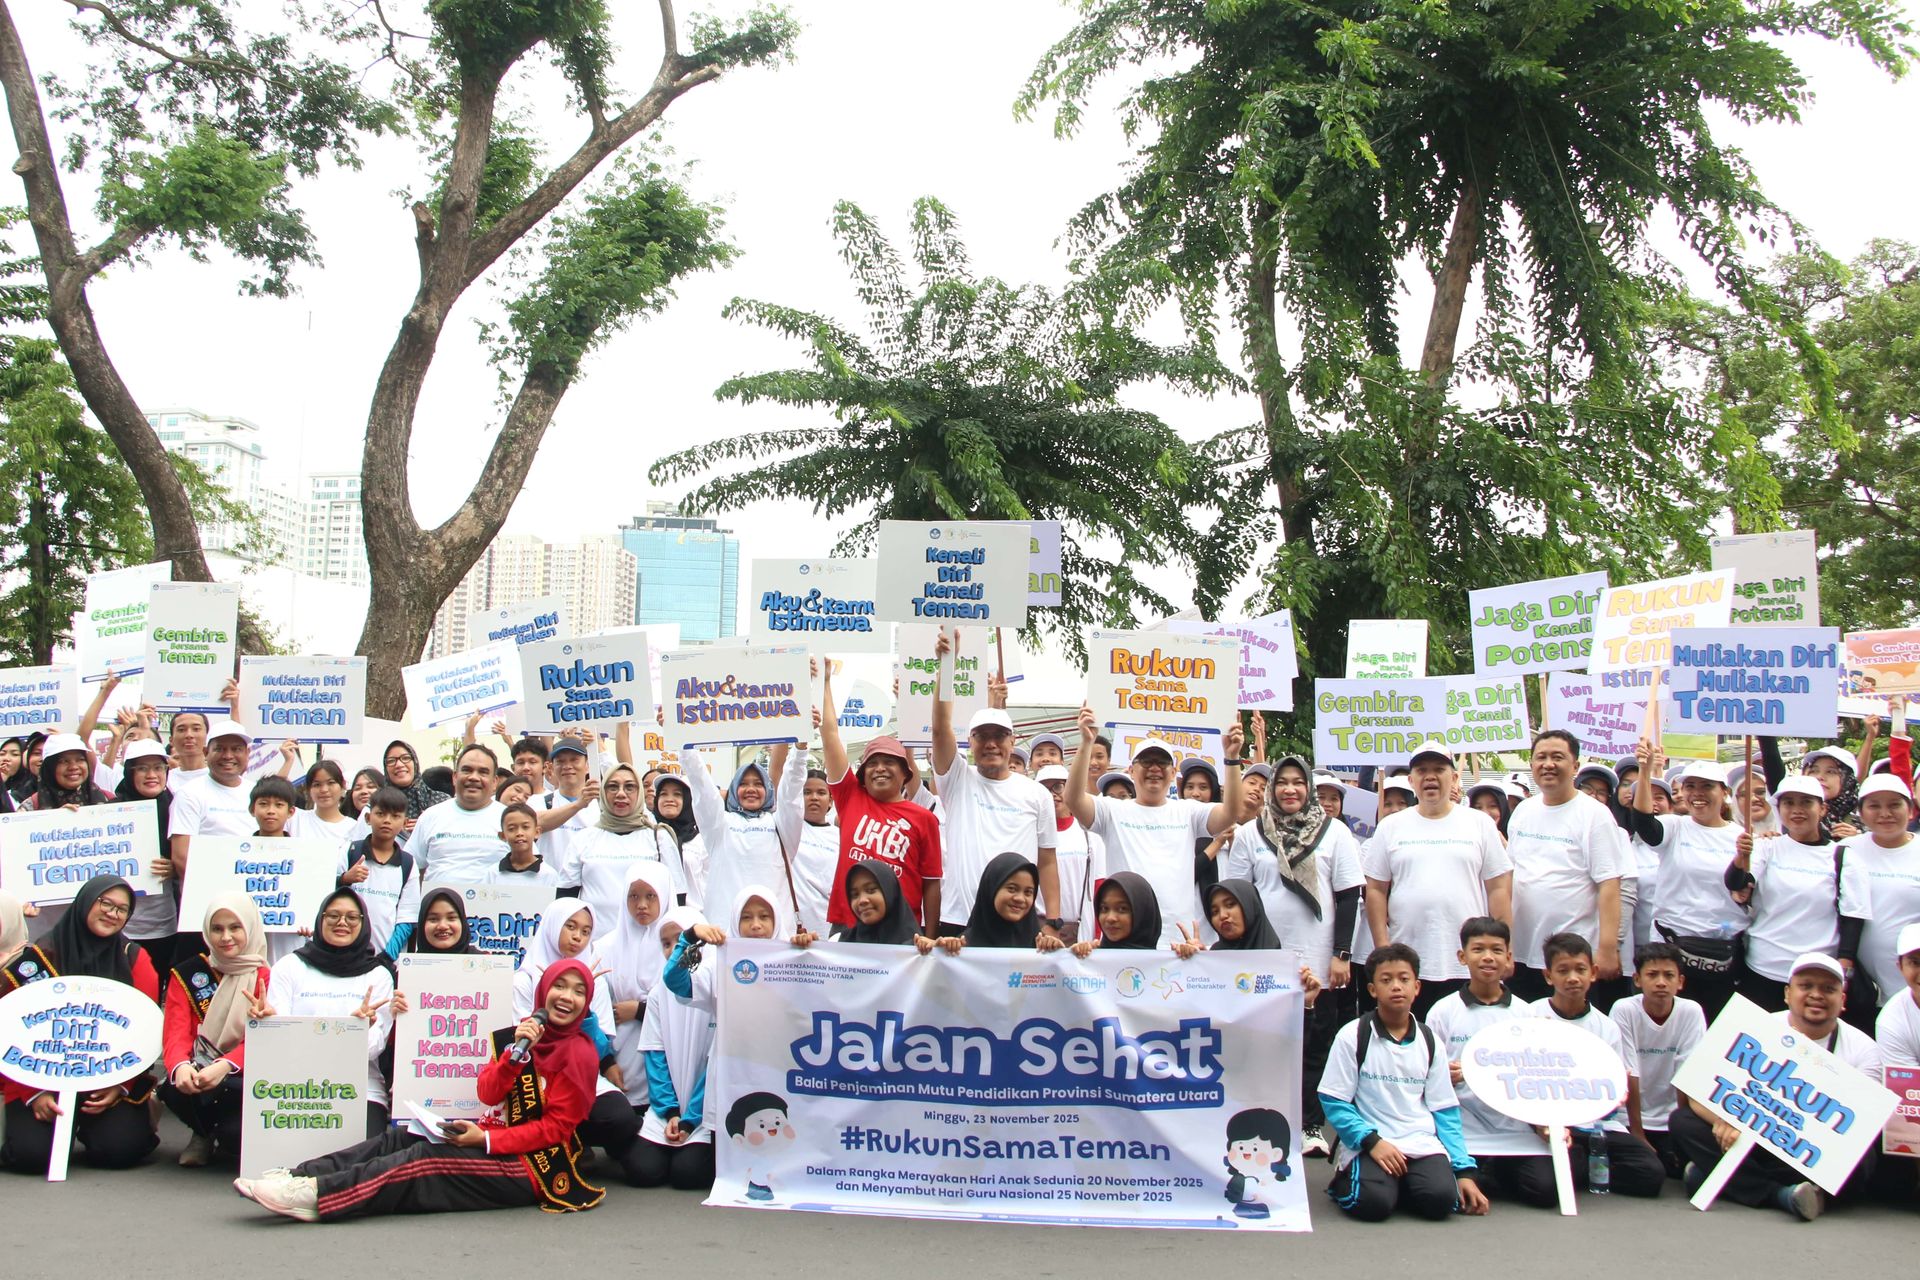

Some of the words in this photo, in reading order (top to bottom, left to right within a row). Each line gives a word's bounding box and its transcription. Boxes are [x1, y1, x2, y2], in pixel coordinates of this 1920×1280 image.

[926, 547, 985, 565] Kenali
[938, 565, 972, 582] Diri
[924, 582, 984, 600] Kenali
[1607, 577, 1725, 618] RUKUN
[1734, 582, 1769, 600] aga
[1772, 576, 1806, 593] Diri
[91, 602, 149, 622] Gembir
[760, 591, 801, 611] Aku
[912, 597, 990, 619] Teman
[1475, 601, 1544, 631] Jaga
[1549, 587, 1604, 618] Dir
[488, 623, 534, 641] Muliakan
[534, 611, 559, 629] Diri
[768, 611, 872, 632] Istimewa
[1534, 617, 1592, 639] Kenali
[1629, 611, 1697, 635] Sama
[153, 627, 228, 643] Gembira
[515, 627, 557, 645] liakan
[158, 650, 217, 664] Teman
[170, 642, 209, 651] Bersama
[1486, 637, 1593, 666] Potens
[1603, 634, 1671, 664] Tem
[1673, 643, 1784, 668] Muliakan
[1791, 642, 1836, 668] Diri
[1872, 642, 1920, 654] Gembira
[1110, 648, 1215, 679] Rukun
[1352, 652, 1388, 665] Jaga
[1393, 651, 1416, 663] Diri
[1854, 655, 1900, 665] bersama
[262, 674, 320, 686] Muliakan
[323, 675, 346, 686] Diri
[425, 661, 478, 683] Muliakan
[480, 656, 501, 671] Diri
[539, 659, 634, 690] Rukun
[39, 680, 61, 691] Diri
[434, 670, 501, 695] Muliakan
[676, 676, 721, 698] Aku
[1135, 677, 1188, 692] Sama
[1696, 669, 1809, 694] Muliakan
[0, 694, 57, 709] uliakan
[268, 689, 342, 703] Muliakan
[428, 679, 509, 712] Teman
[565, 686, 612, 703] Sama
[1115, 688, 1208, 714] Teman
[1318, 690, 1424, 713] Gembira
[1475, 682, 1524, 706] Diri
[258, 704, 346, 725] Teman
[547, 699, 633, 724] Teman
[676, 699, 801, 725] Istimewa
[1463, 706, 1512, 722] Kenali
[1673, 690, 1784, 724] Teman
[1350, 714, 1414, 726] Bersama
[1599, 716, 1636, 733] Jalan
[1446, 719, 1524, 744] otensi
[30, 826, 103, 844] Muliakan
[107, 820, 134, 837] Diri
[40, 839, 132, 862] Muliakan
[28, 857, 139, 886] Teman
[235, 859, 294, 875] Kenali
[246, 876, 279, 892] Diri
[498, 912, 542, 937] Diri
[478, 937, 520, 950] Kenali
[785, 963, 827, 971] PENJAMINAN
[848, 967, 889, 975] PENDIDIKAN
[796, 970, 830, 978] SUMATERA
[763, 976, 825, 985] KEMENDIKDASMEN
[1062, 977, 1106, 989] RAMAH
[420, 991, 490, 1011] Kenali
[21, 1002, 130, 1029] Kendalikan
[430, 1014, 478, 1038] Diri
[51, 1019, 100, 1041] Diri
[33, 1040, 68, 1055] Pilih
[69, 1040, 110, 1052] Jalan
[418, 1038, 488, 1058] Kenali
[799, 1018, 992, 1076] Jalan
[1018, 1025, 1214, 1079] Sehat
[1473, 1047, 1577, 1068] Gembira
[2, 1046, 141, 1077] Bermakna
[253, 1079, 357, 1100] Gembira
[521, 1074, 536, 1110] DUTA
[794, 1075, 828, 1089] Balai
[830, 1079, 915, 1096] Penjaminan
[918, 1084, 954, 1097] Mutu
[957, 1086, 1039, 1100] Pendidikan
[1042, 1086, 1101, 1100] Provinsi
[1104, 1088, 1175, 1104] Sumatera
[1178, 1088, 1218, 1102] Utara
[1497, 1073, 1616, 1101] Teman
[1725, 1032, 1855, 1135] Rukun
[278, 1100, 332, 1110] Bersama
[1742, 1079, 1807, 1131] Sama
[261, 1110, 343, 1130] Teman
[924, 1110, 969, 1124] Minggu,
[973, 1114, 986, 1124] 23
[990, 1114, 1049, 1124] November
[1053, 1114, 1080, 1123] 2025
[1708, 1075, 1822, 1169] Teman
[840, 1125, 1171, 1161] #RukunSamaTeman
[534, 1151, 551, 1173] 2023
[806, 1165, 847, 1177] Dalam
[849, 1167, 895, 1181] Rangka
[898, 1170, 967, 1186] Merayakan
[970, 1174, 995, 1185] Hari
[998, 1175, 1031, 1186] Anak
[1033, 1175, 1084, 1187] Sedunia
[1087, 1176, 1102, 1186] 20
[1105, 1176, 1171, 1187] November
[1173, 1177, 1203, 1187] 2025
[835, 1180, 861, 1192] dan
[863, 1183, 936, 1198] Menyambut
[938, 1186, 963, 1198] Hari
[966, 1188, 996, 1199] Guru
[999, 1188, 1054, 1200] Nasional
[1057, 1190, 1072, 1200] 25
[1074, 1190, 1140, 1202] November
[1142, 1191, 1173, 1202] 2025
